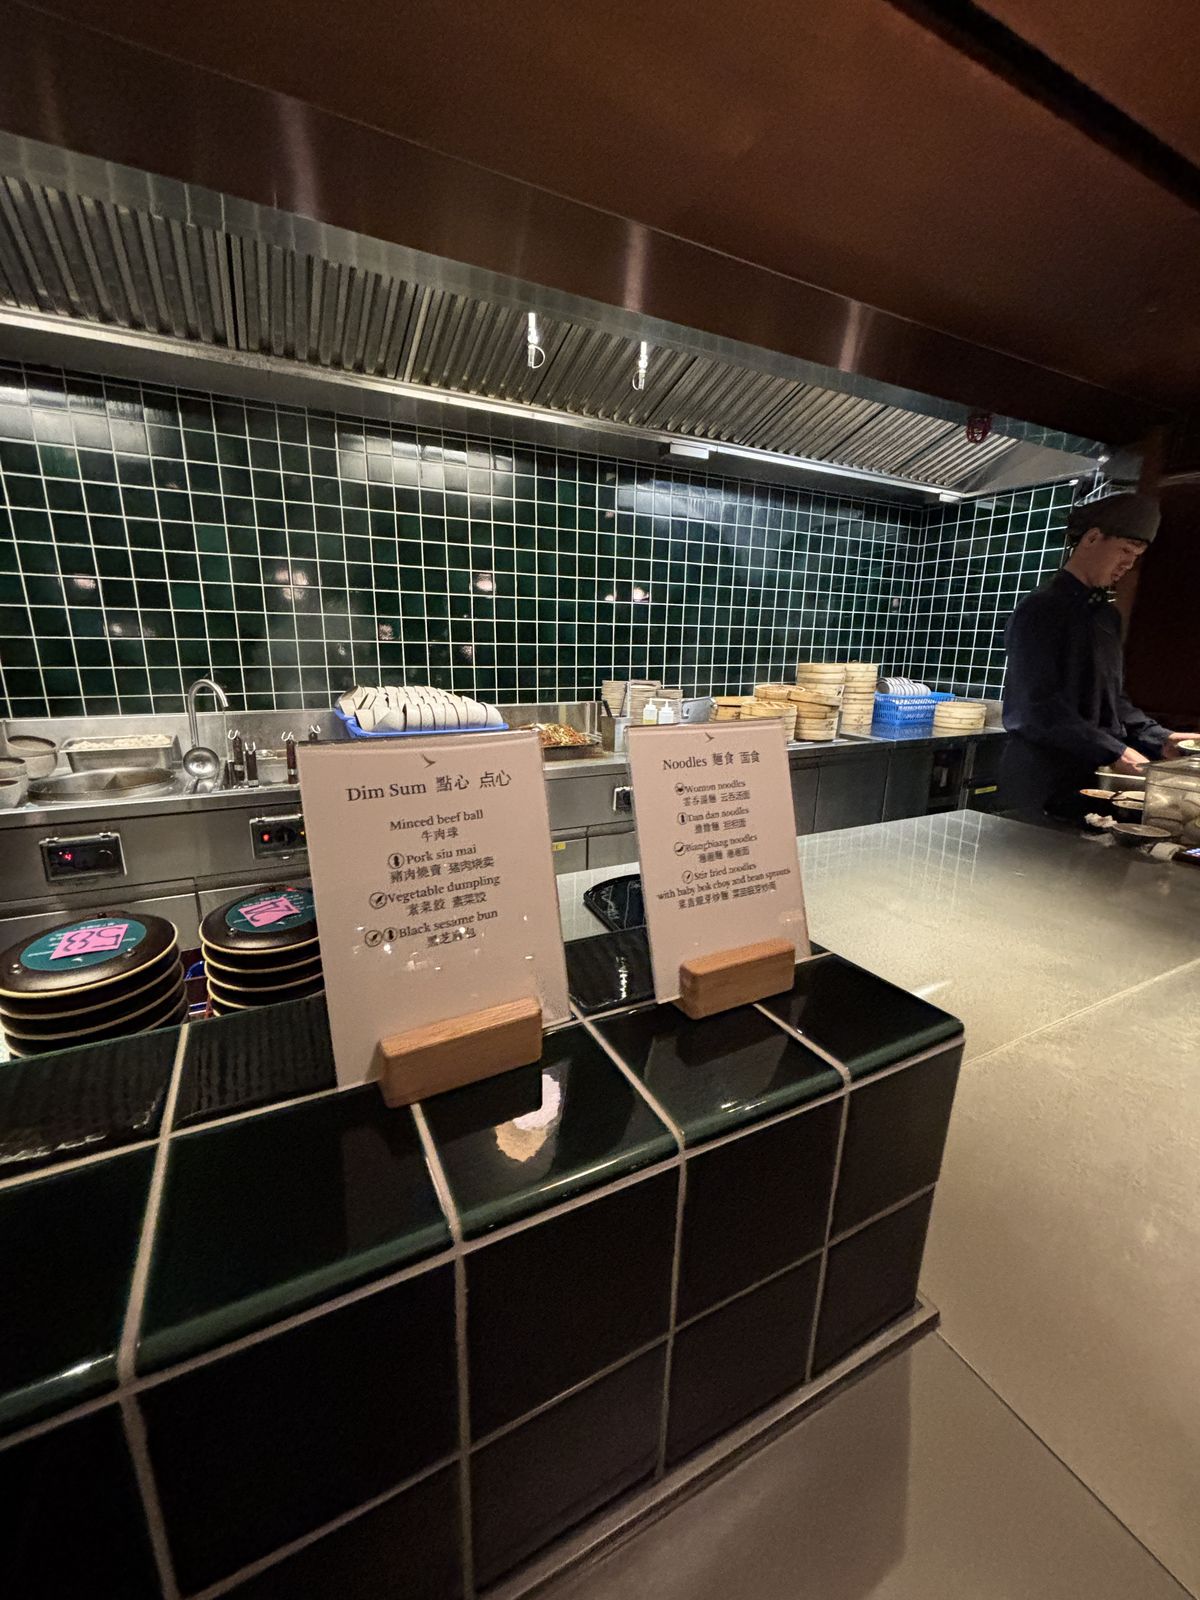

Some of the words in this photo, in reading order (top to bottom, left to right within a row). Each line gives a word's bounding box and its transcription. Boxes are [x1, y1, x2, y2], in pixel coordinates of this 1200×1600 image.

[662, 756, 708, 771] Noodles
[739, 750, 761, 764] 面食
[346, 784, 385, 802] Dim
[389, 780, 427, 798] Sum
[436, 774, 470, 793] 點心
[479, 769, 512, 789] 点心
[717, 779, 746, 791] noodles
[389, 815, 434, 832] Minced
[437, 811, 462, 826] beef
[463, 809, 484, 822] ball
[705, 809, 720, 820] dan
[721, 806, 750, 818] noodles
[729, 833, 758, 846] noodles
[406, 850, 434, 865] Pork
[435, 847, 453, 861] siu
[455, 844, 477, 857] mai
[709, 866, 727, 878] fried
[728, 863, 757, 875] noodles
[386, 884, 445, 905] Vegetable
[446, 874, 501, 895] dumpling
[656, 888, 676, 901] with
[677, 886, 696, 900] baby
[697, 881, 712, 893] bok
[731, 875, 746, 886] and
[399, 922, 431, 939] Black
[433, 915, 475, 932] sesame
[476, 908, 499, 922] bun
